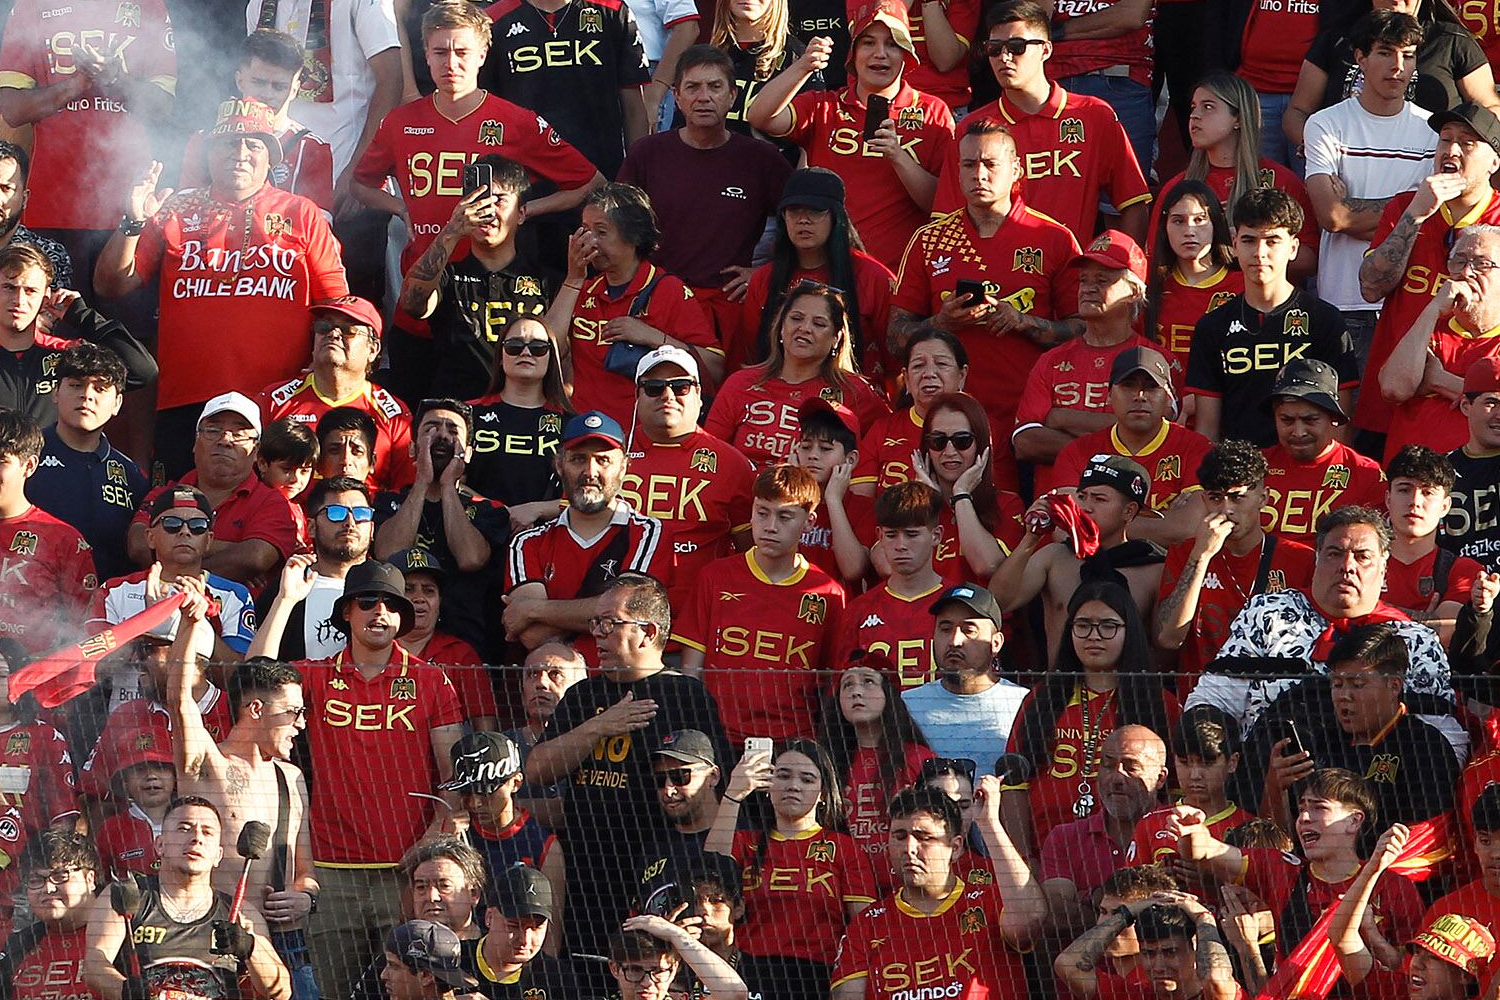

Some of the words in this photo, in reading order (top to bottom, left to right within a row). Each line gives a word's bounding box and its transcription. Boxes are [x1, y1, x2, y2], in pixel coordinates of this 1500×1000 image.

[804, 17, 842, 31] SEK
[513, 40, 603, 73] SEK
[94, 97, 128, 113] Frits
[410, 152, 481, 197] SE
[1017, 149, 1082, 180] EK
[180, 241, 297, 277] Banesto
[172, 276, 236, 299] CHILE
[239, 277, 298, 300] BANK
[572, 316, 610, 341] SE
[1225, 342, 1312, 372] SEK
[1054, 381, 1110, 409] SE
[749, 400, 801, 433] SE
[474, 429, 562, 455] SEK
[747, 430, 800, 455] stark
[1451, 489, 1500, 536] SE
[1459, 539, 1500, 559] starke
[721, 626, 816, 670] SEK
[325, 701, 418, 733] SEK
[590, 770, 628, 789] VENDE
[880, 948, 976, 993] SEK
